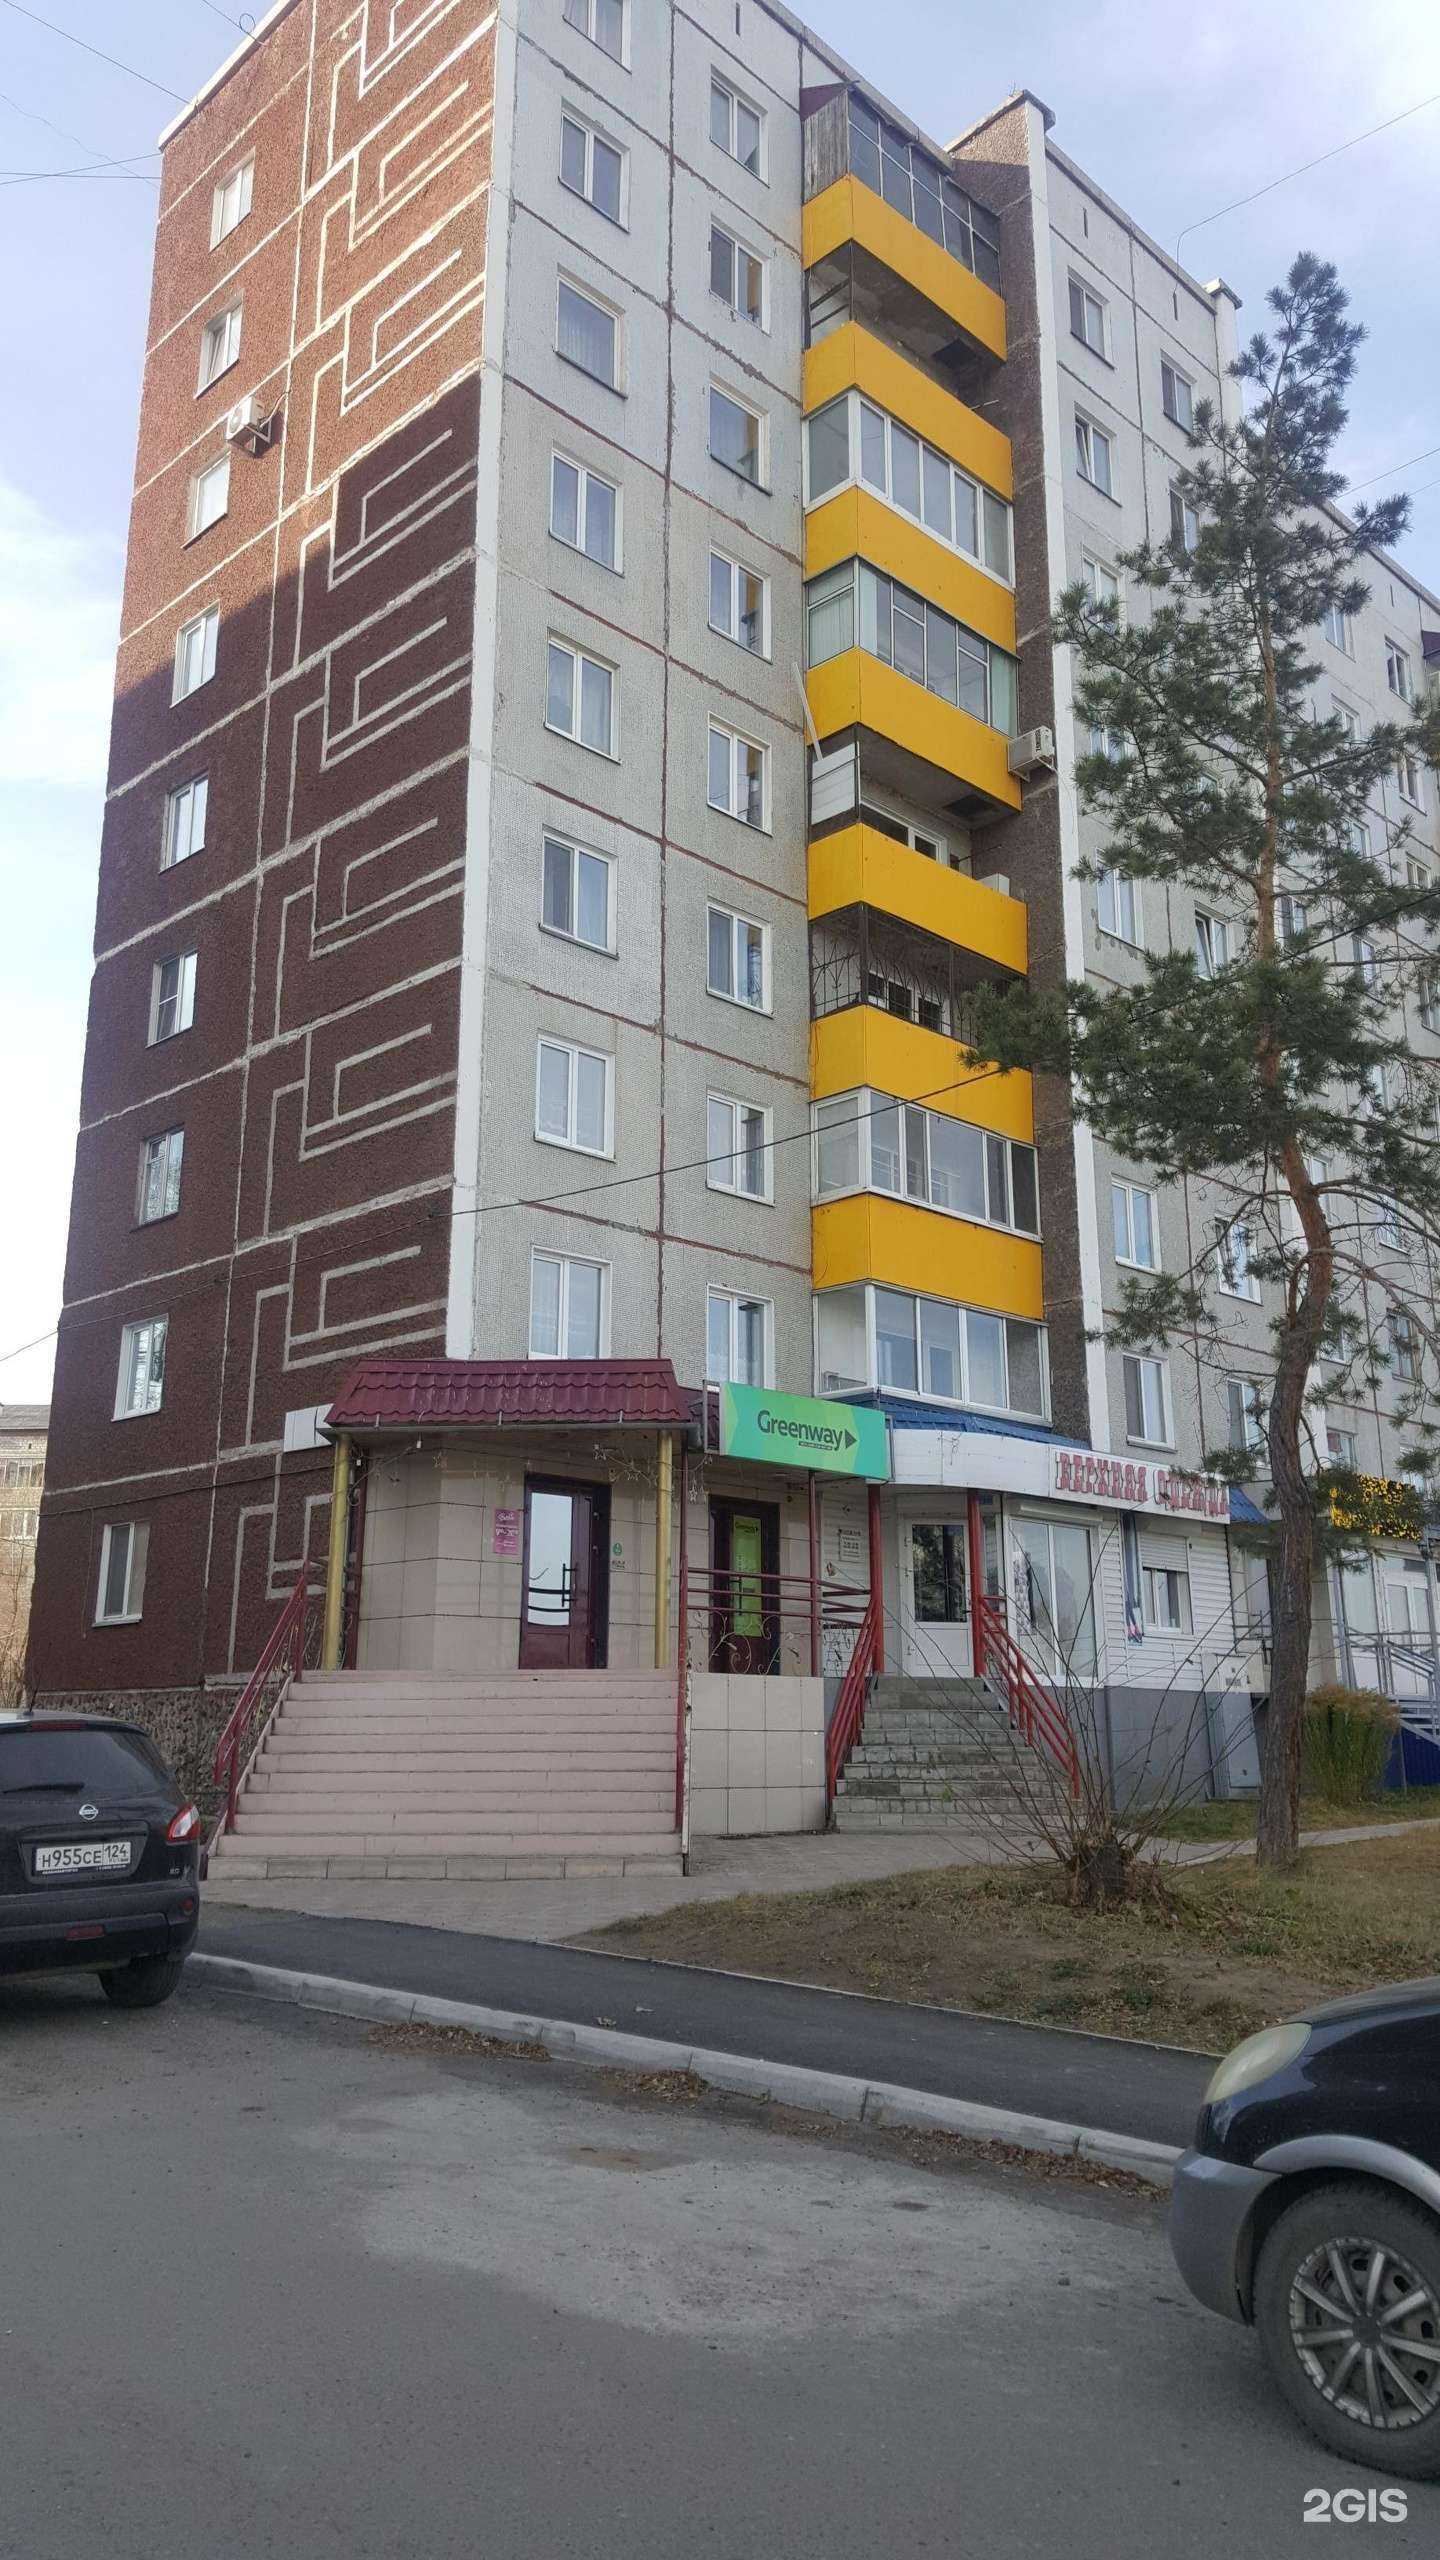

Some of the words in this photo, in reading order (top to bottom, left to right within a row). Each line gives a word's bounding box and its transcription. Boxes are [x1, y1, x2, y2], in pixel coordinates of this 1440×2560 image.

[757, 1409, 843, 1451] Greenway
[1056, 1451, 1149, 1503] ВЕРХНЯЯ
[105, 1844, 127, 1858] 124
